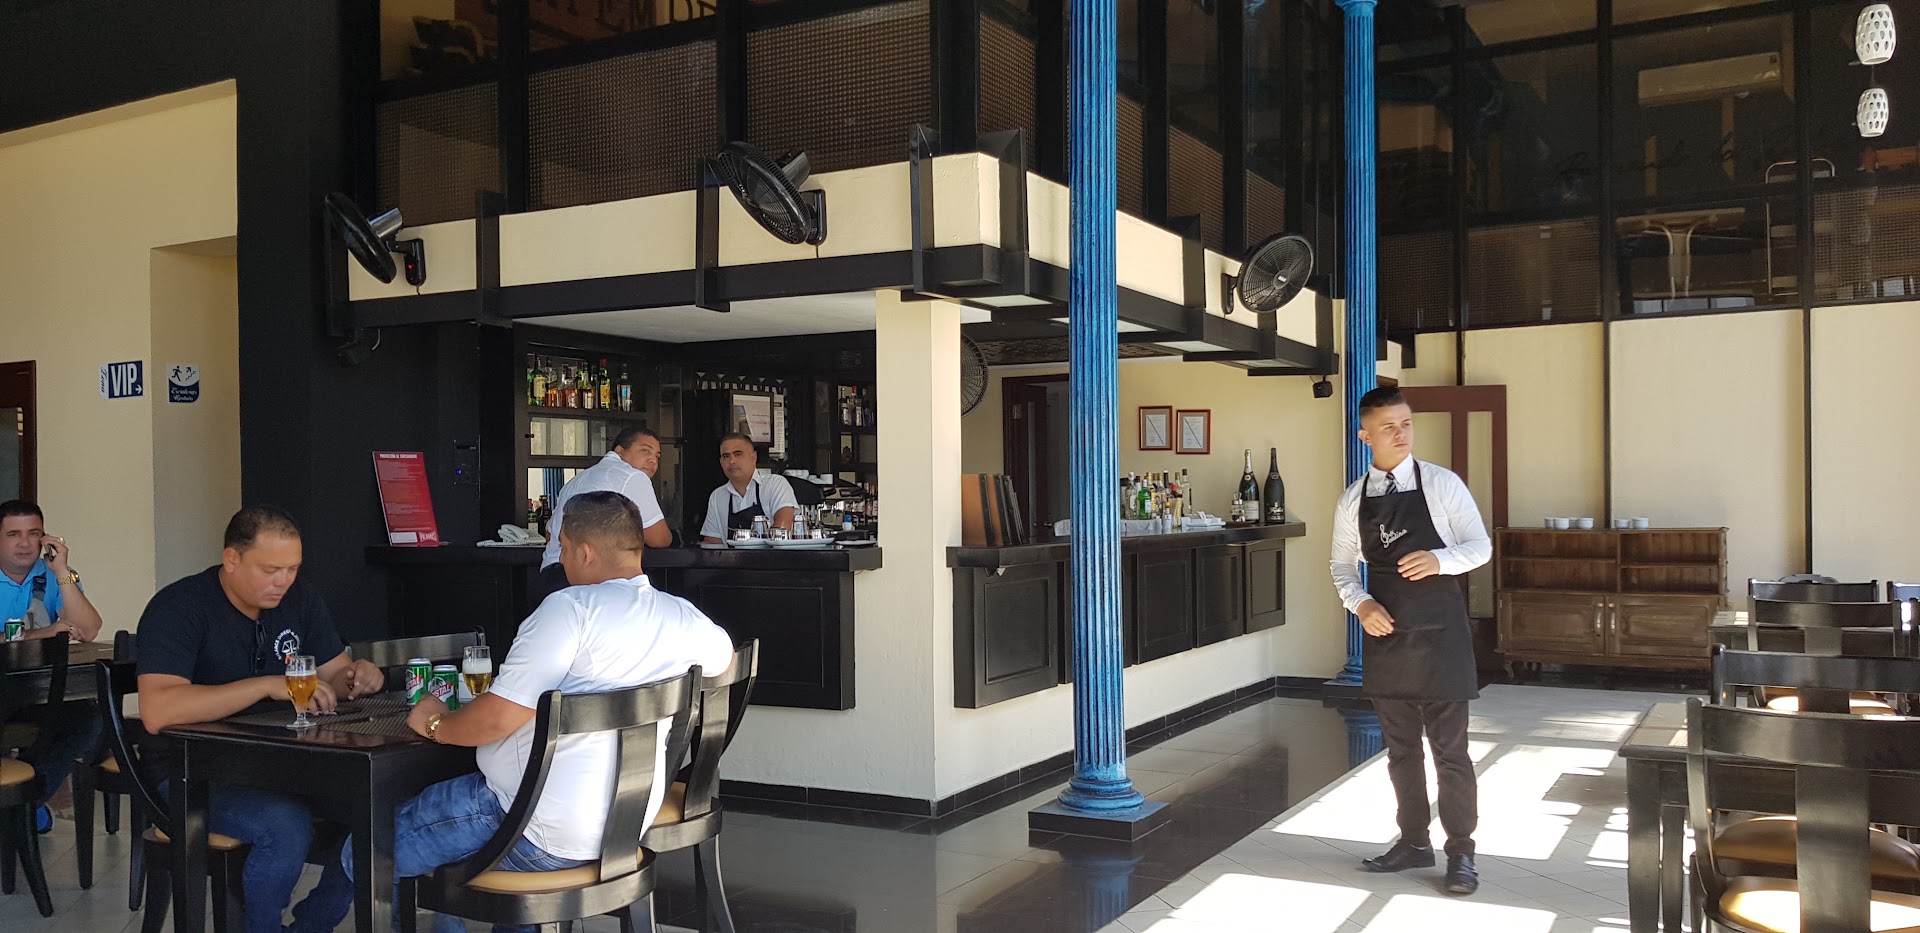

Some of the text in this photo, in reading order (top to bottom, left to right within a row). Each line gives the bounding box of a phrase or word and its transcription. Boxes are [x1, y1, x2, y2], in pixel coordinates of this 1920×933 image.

[110, 363, 137, 396] VIP
[405, 675, 421, 689] STAL
[434, 684, 451, 697] STAL
